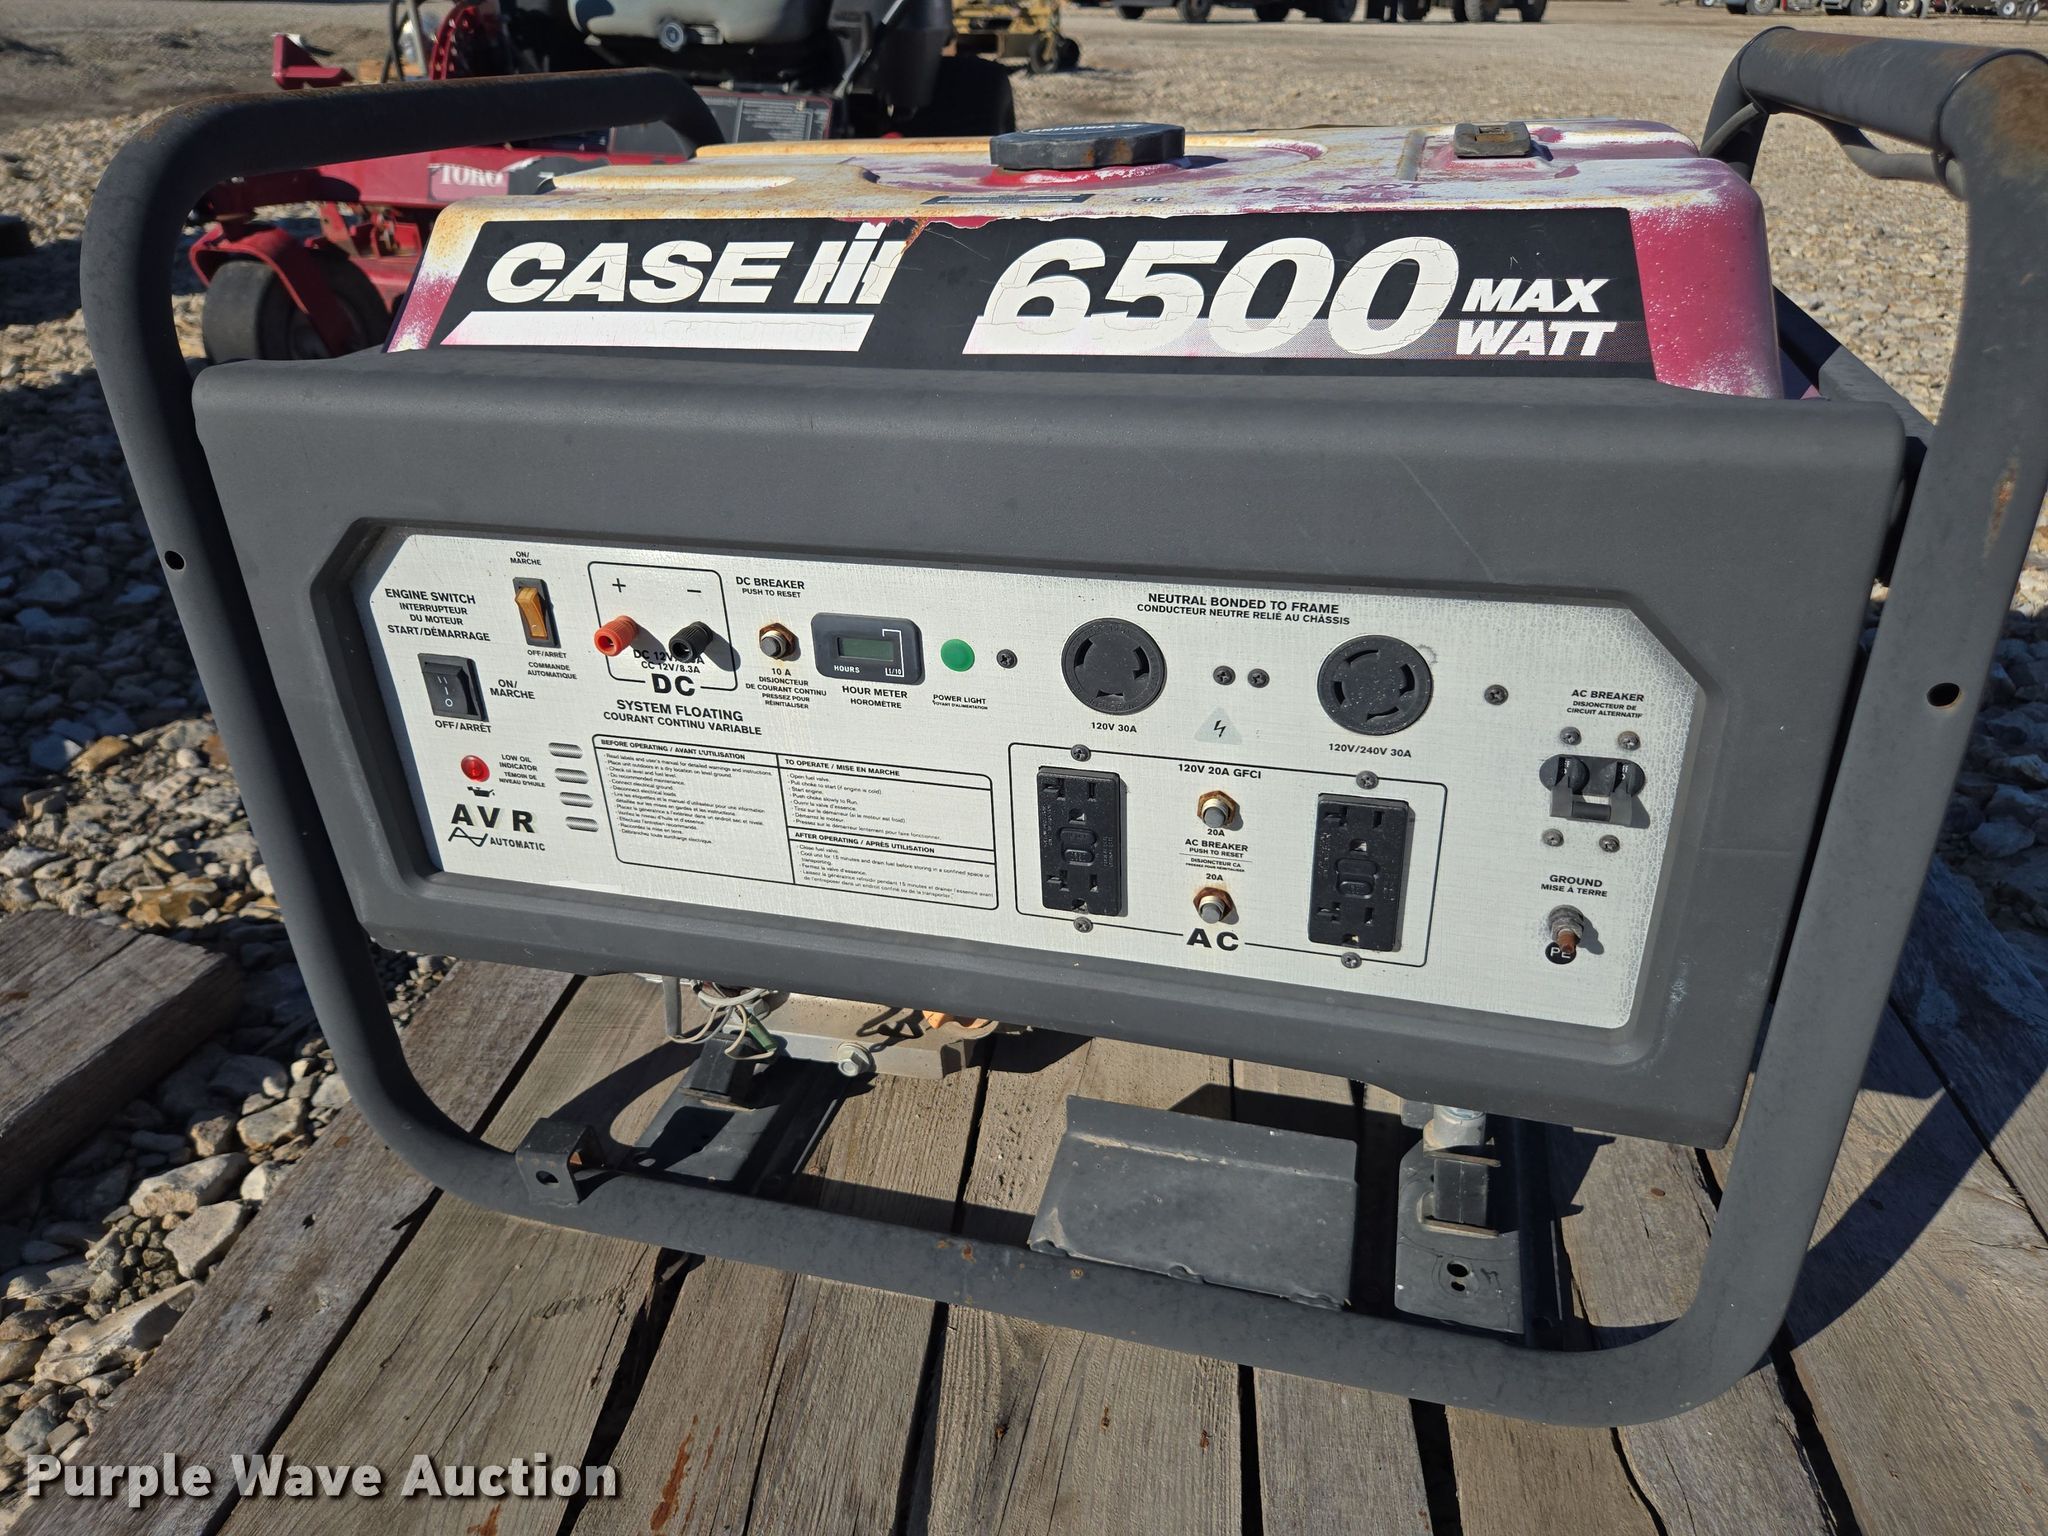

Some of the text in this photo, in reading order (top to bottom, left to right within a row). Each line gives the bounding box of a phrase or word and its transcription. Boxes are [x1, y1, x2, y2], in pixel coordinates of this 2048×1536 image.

[441, 166, 504, 187] TORO
[486, 240, 794, 303] CASE
[964, 236, 1459, 355] 6500
[1464, 278, 1609, 314] MAX
[1455, 320, 1616, 357] WATT
[510, 557, 542, 566] MARCHE
[736, 576, 805, 590] DC BREAKER
[385, 588, 476, 604] ENGINE SWITCH
[742, 588, 762, 596] PUSH
[777, 590, 801, 599] RESET
[400, 602, 468, 615] INTERRUPTEUR
[1148, 593, 1339, 614] NEUTRAL BONDED TO FRAME
[410, 614, 464, 625] DU MOTEUR
[1137, 604, 1206, 616] CONDUCTEUR
[1209, 607, 1250, 619] NEUTRE
[1252, 609, 1282, 621] RELIÉ
[1285, 612, 1300, 622] AU
[387, 624, 491, 642] START/DÉMARRAGE
[633, 649, 649, 659] DC
[528, 661, 570, 671] COMMANDE
[641, 661, 701, 674] CC 12V/8.3A
[771, 667, 792, 677] 10 A
[834, 665, 860, 674] HOURS
[527, 669, 578, 680] AUTOMATIQUE
[498, 679, 518, 688] ON/
[651, 673, 695, 696] DC
[759, 676, 809, 687] DISJONCTEUR
[490, 687, 536, 700] MARCHE
[745, 682, 827, 697] DE COURANT CONTINU
[842, 685, 908, 698] HOUR METER
[1571, 689, 1644, 702] AC BREAKER
[761, 692, 810, 703] PRESSEZ POUR
[933, 694, 962, 702] POWER
[617, 699, 743, 722] SYSTEM FLOATING
[1573, 700, 1624, 710] DISJONCTEUR
[1566, 707, 1644, 719] CIRCUIT ALTERNATIF
[603, 711, 762, 736] COURANT CONTINU VARIABLE
[1091, 722, 1137, 733] 120V 30A
[600, 739, 628, 747] BEFORE
[629, 742, 668, 751] OPERATING
[1328, 743, 1412, 758] 120V/240V 30A
[499, 762, 538, 771] INDICATOR
[796, 760, 829, 768] OPERATE
[868, 767, 900, 776] MARCHE
[1178, 763, 1262, 779] 120V 20A GFCI
[1207, 828, 1225, 837] 20A
[490, 837, 546, 851] AUTOMATIC
[794, 831, 817, 839] AFTER
[818, 834, 858, 844] OPERATING
[891, 843, 934, 853] UTILISATION
[1185, 838, 1248, 852] AC BREAKER
[1190, 857, 1231, 866] DISJONCTEUR
[1221, 851, 1243, 859] RESET
[1206, 873, 1224, 881] 20A
[1549, 874, 1603, 888] GROUND
[1540, 883, 1608, 898] MISE À TERRE
[1186, 928, 1239, 951] AC
